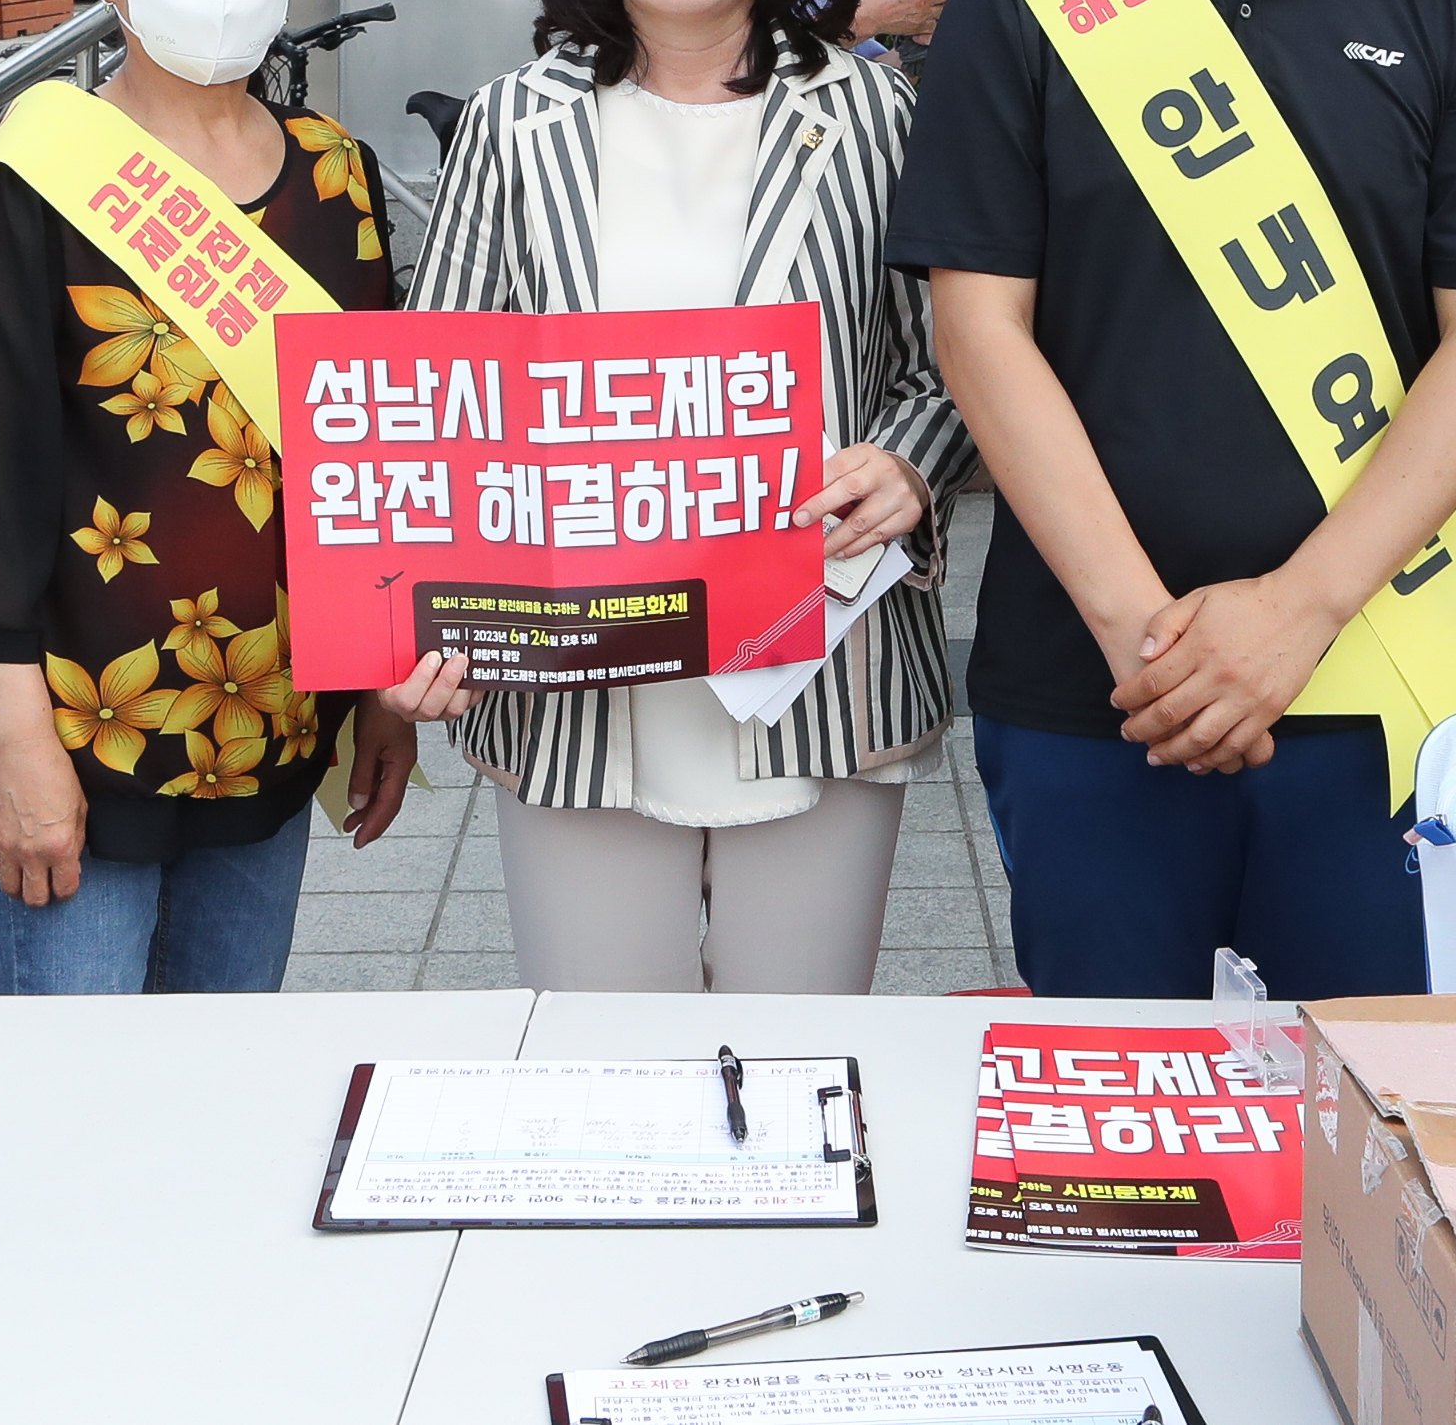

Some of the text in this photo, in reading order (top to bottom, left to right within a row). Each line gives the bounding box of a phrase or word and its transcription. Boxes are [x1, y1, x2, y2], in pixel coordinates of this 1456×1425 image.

[88, 151, 173, 233] 고도
[128, 183, 211, 273] 제한
[168, 219, 250, 309] 완전
[205, 256, 289, 347] 해결
[304, 351, 795, 444] 성남시 고도제한
[310, 446, 799, 548] 완전 해결하라!
[431, 597, 458, 609] 성남시
[460, 597, 496, 610] 고도제한
[498, 599, 541, 614] 완전해결을
[587, 592, 688, 619] 시민문화제
[442, 628, 598, 647] 일시 2023년 6월 24일 오후 5시
[472, 649, 500, 661] 야탑역
[502, 650, 521, 662] 광장
[472, 660, 682, 683] 성남시 고도제한 완전해결을 위한 범시민대책위원회
[696, 1068, 760, 1076] 고한
[447, 1194, 516, 1204] 성남시민
[527, 1194, 563, 1204] 90만
[655, 1196, 743, 1206] 완전해결을
[753, 1196, 825, 1205] 고도제한
[1062, 1183, 1197, 1201] 시민문화제
[974, 1207, 1023, 1219] 오후 5시
[1029, 1202, 1077, 1213] 오후 5시
[1067, 1227, 1093, 1236] 위한
[608, 1378, 691, 1390] 고도제한
[702, 1374, 802, 1389] 완전해결을
[903, 1368, 945, 1379] 90만
[956, 1364, 1035, 1377] 성남시민
[1047, 1361, 1125, 1374] 서명운동
